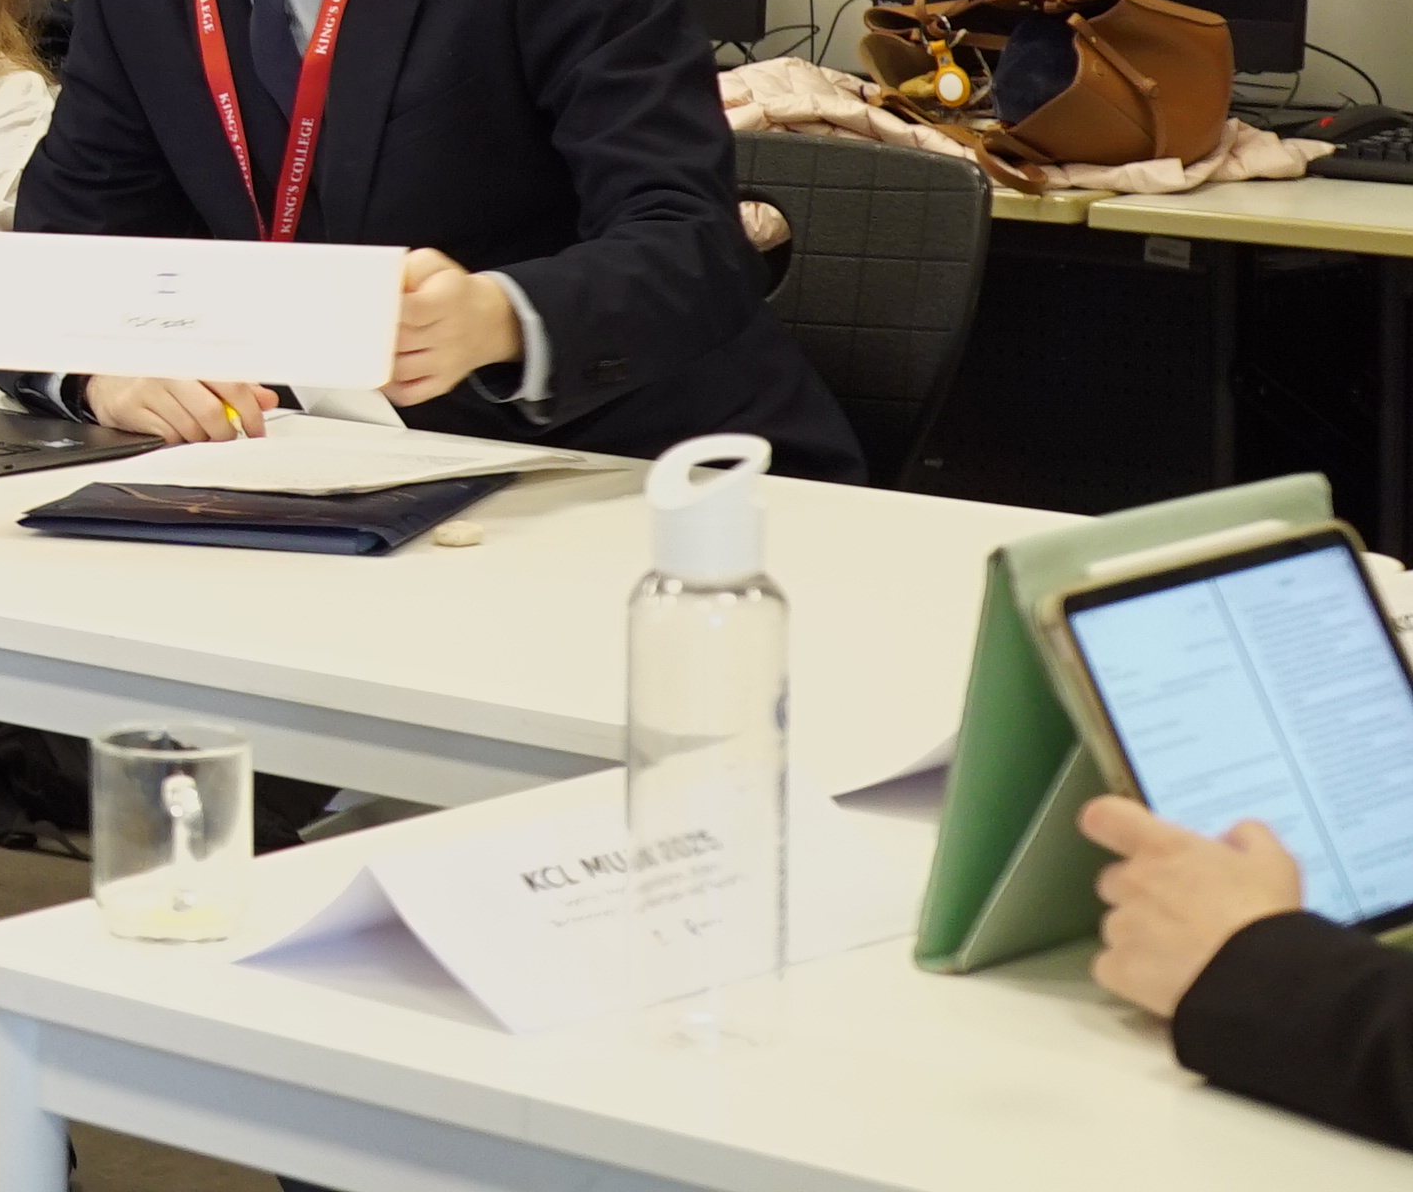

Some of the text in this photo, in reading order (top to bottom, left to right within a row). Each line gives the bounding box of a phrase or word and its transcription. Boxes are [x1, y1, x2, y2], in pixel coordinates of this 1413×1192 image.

[315, 4, 340, 56] KING'S
[218, 92, 238, 144] KING'S
[281, 117, 315, 234] KING'S COLLEGE
[519, 864, 580, 893] KCL
